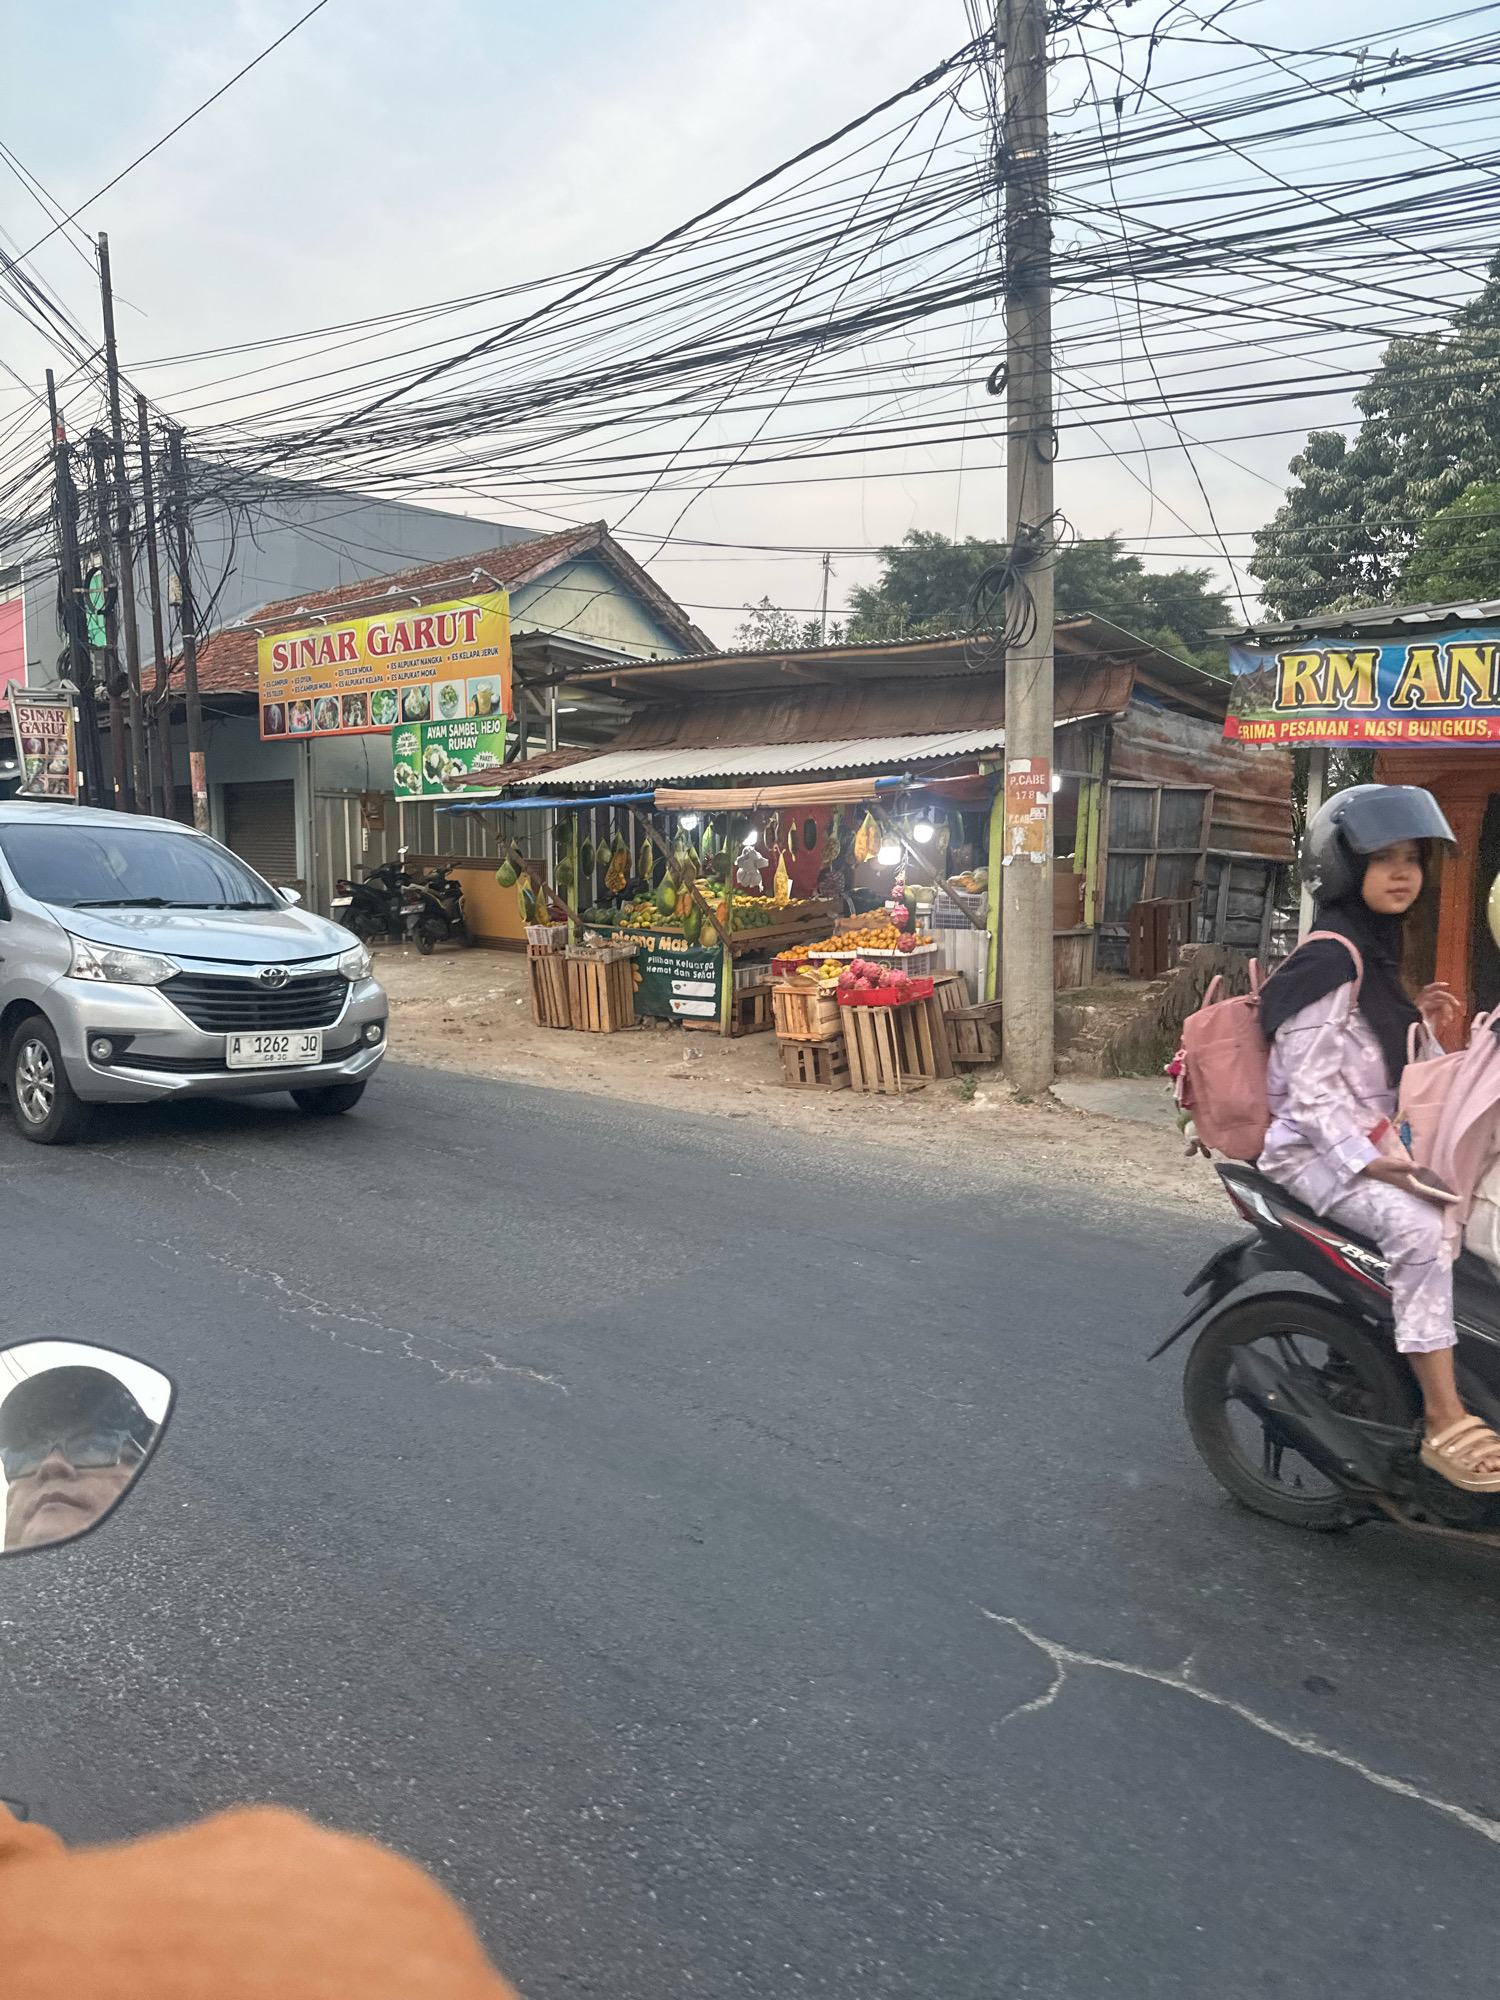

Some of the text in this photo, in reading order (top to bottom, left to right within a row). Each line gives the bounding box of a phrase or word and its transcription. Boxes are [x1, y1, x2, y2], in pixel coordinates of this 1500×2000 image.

[272, 607, 483, 673] SINAR GARUT
[452, 647, 499, 661] ES KELAPA JERUK
[398, 658, 420, 669] ALPUKAT
[420, 656, 442, 666] NANGKA
[344, 668, 358, 676] TELER
[358, 666, 372, 674] MOKA
[398, 670, 420, 680] ALPUKAT
[420, 668, 436, 678] MOKA
[1274, 641, 1500, 710] RM AN
[272, 679, 288, 687] CAMPUR
[300, 684, 318, 692] CAMPUR
[318, 682, 332, 690] MOKA
[345, 678, 365, 686] ALPUKAT
[365, 676, 384, 684] KELAPA
[20, 709, 65, 722] SINAR
[19, 722, 67, 735] GARUT
[427, 718, 501, 739] AYAM SAMBEL HEJO
[1280, 721, 1349, 738] PESANAN
[1364, 721, 1404, 737] NASI
[1407, 719, 1492, 739] BUNGKUS,
[448, 736, 478, 751] RUHAY
[1010, 774, 1046, 786] P.CABE
[1016, 791, 1036, 800] 178
[659, 936, 688, 952] Mas
[648, 956, 714, 971] Pilihan Keluarga
[646, 966, 716, 979] Hemat dan Sehat
[232, 1036, 318, 1054] A 1262 JQ
